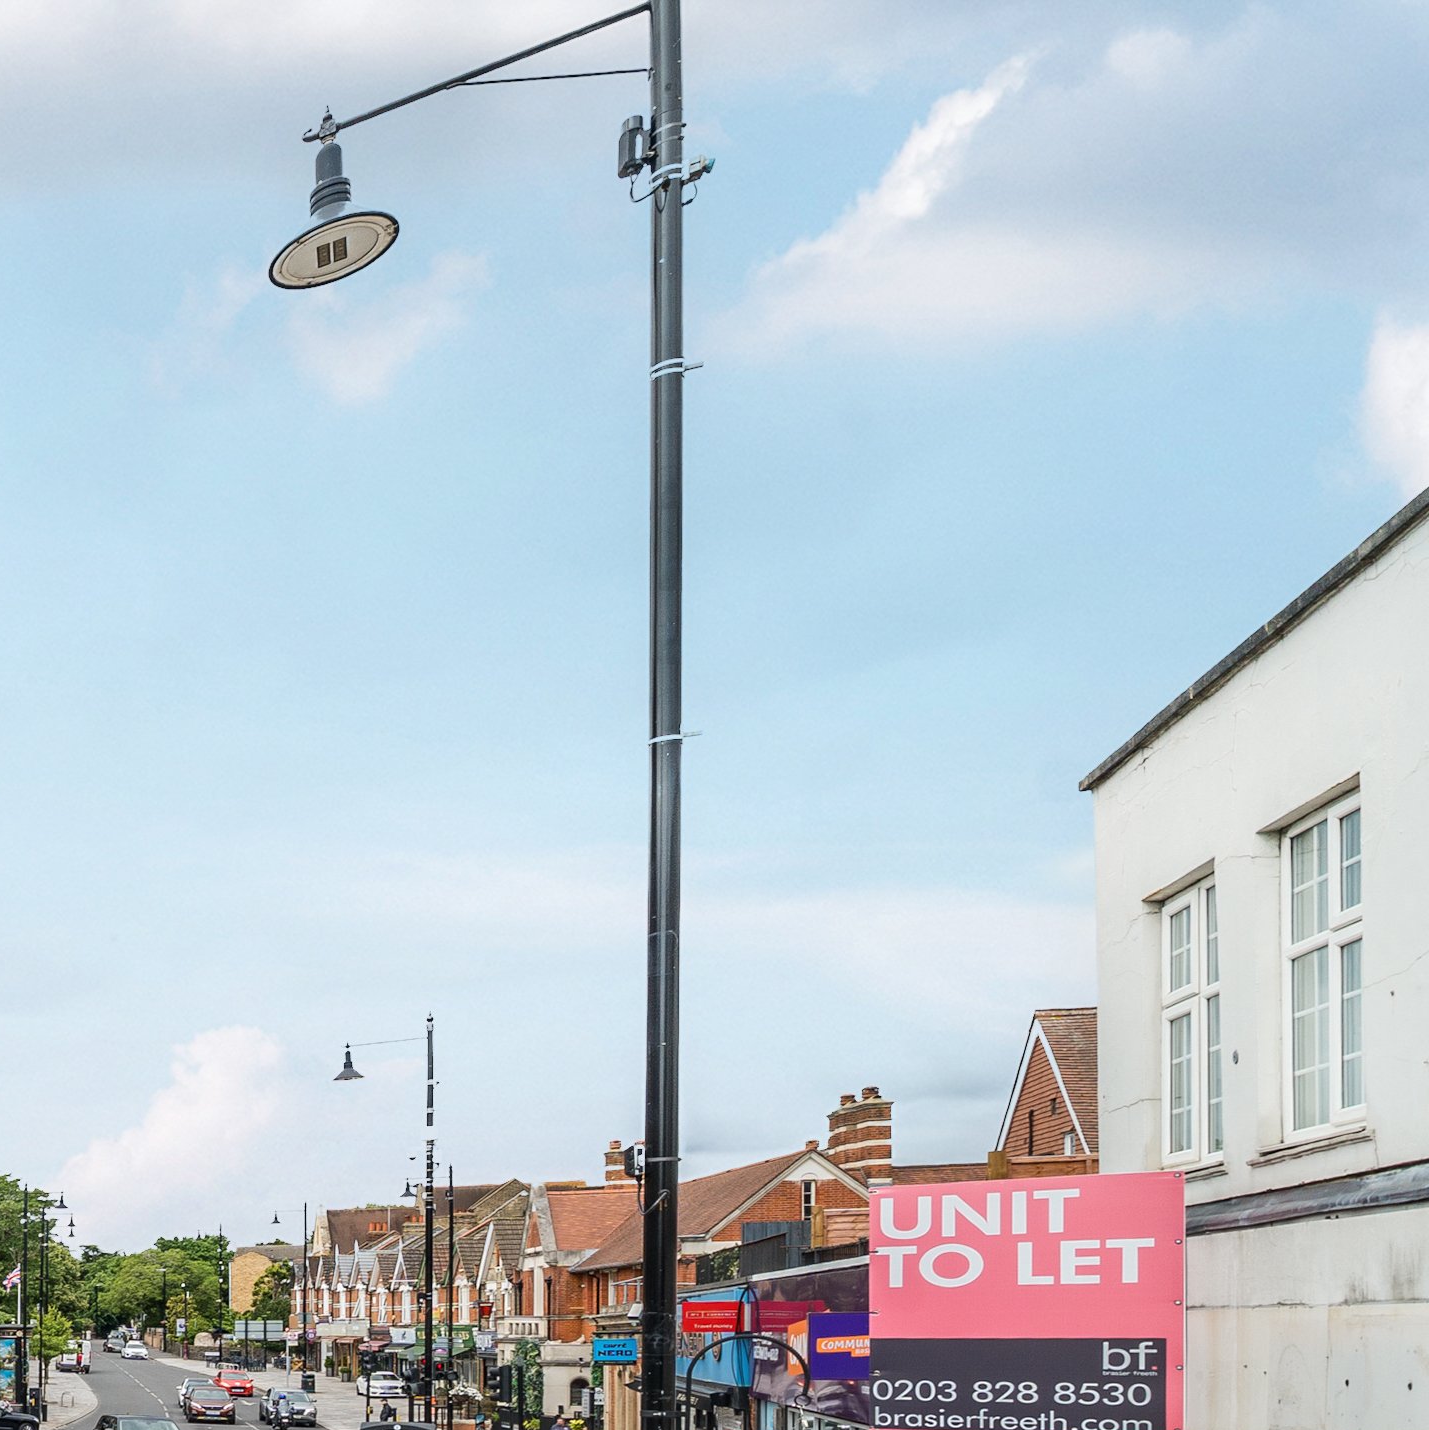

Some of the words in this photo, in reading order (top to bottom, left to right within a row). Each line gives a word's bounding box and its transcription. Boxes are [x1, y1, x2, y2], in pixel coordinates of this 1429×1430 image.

[880, 1188, 1080, 1239] UNIT
[875, 1243, 984, 1288] TO
[1017, 1238, 1155, 1285] LET
[821, 1336, 869, 1349] COMMUN
[873, 1380, 957, 1402] 0203
[972, 1381, 1038, 1404] 828
[1053, 1382, 1152, 1406] 8530
